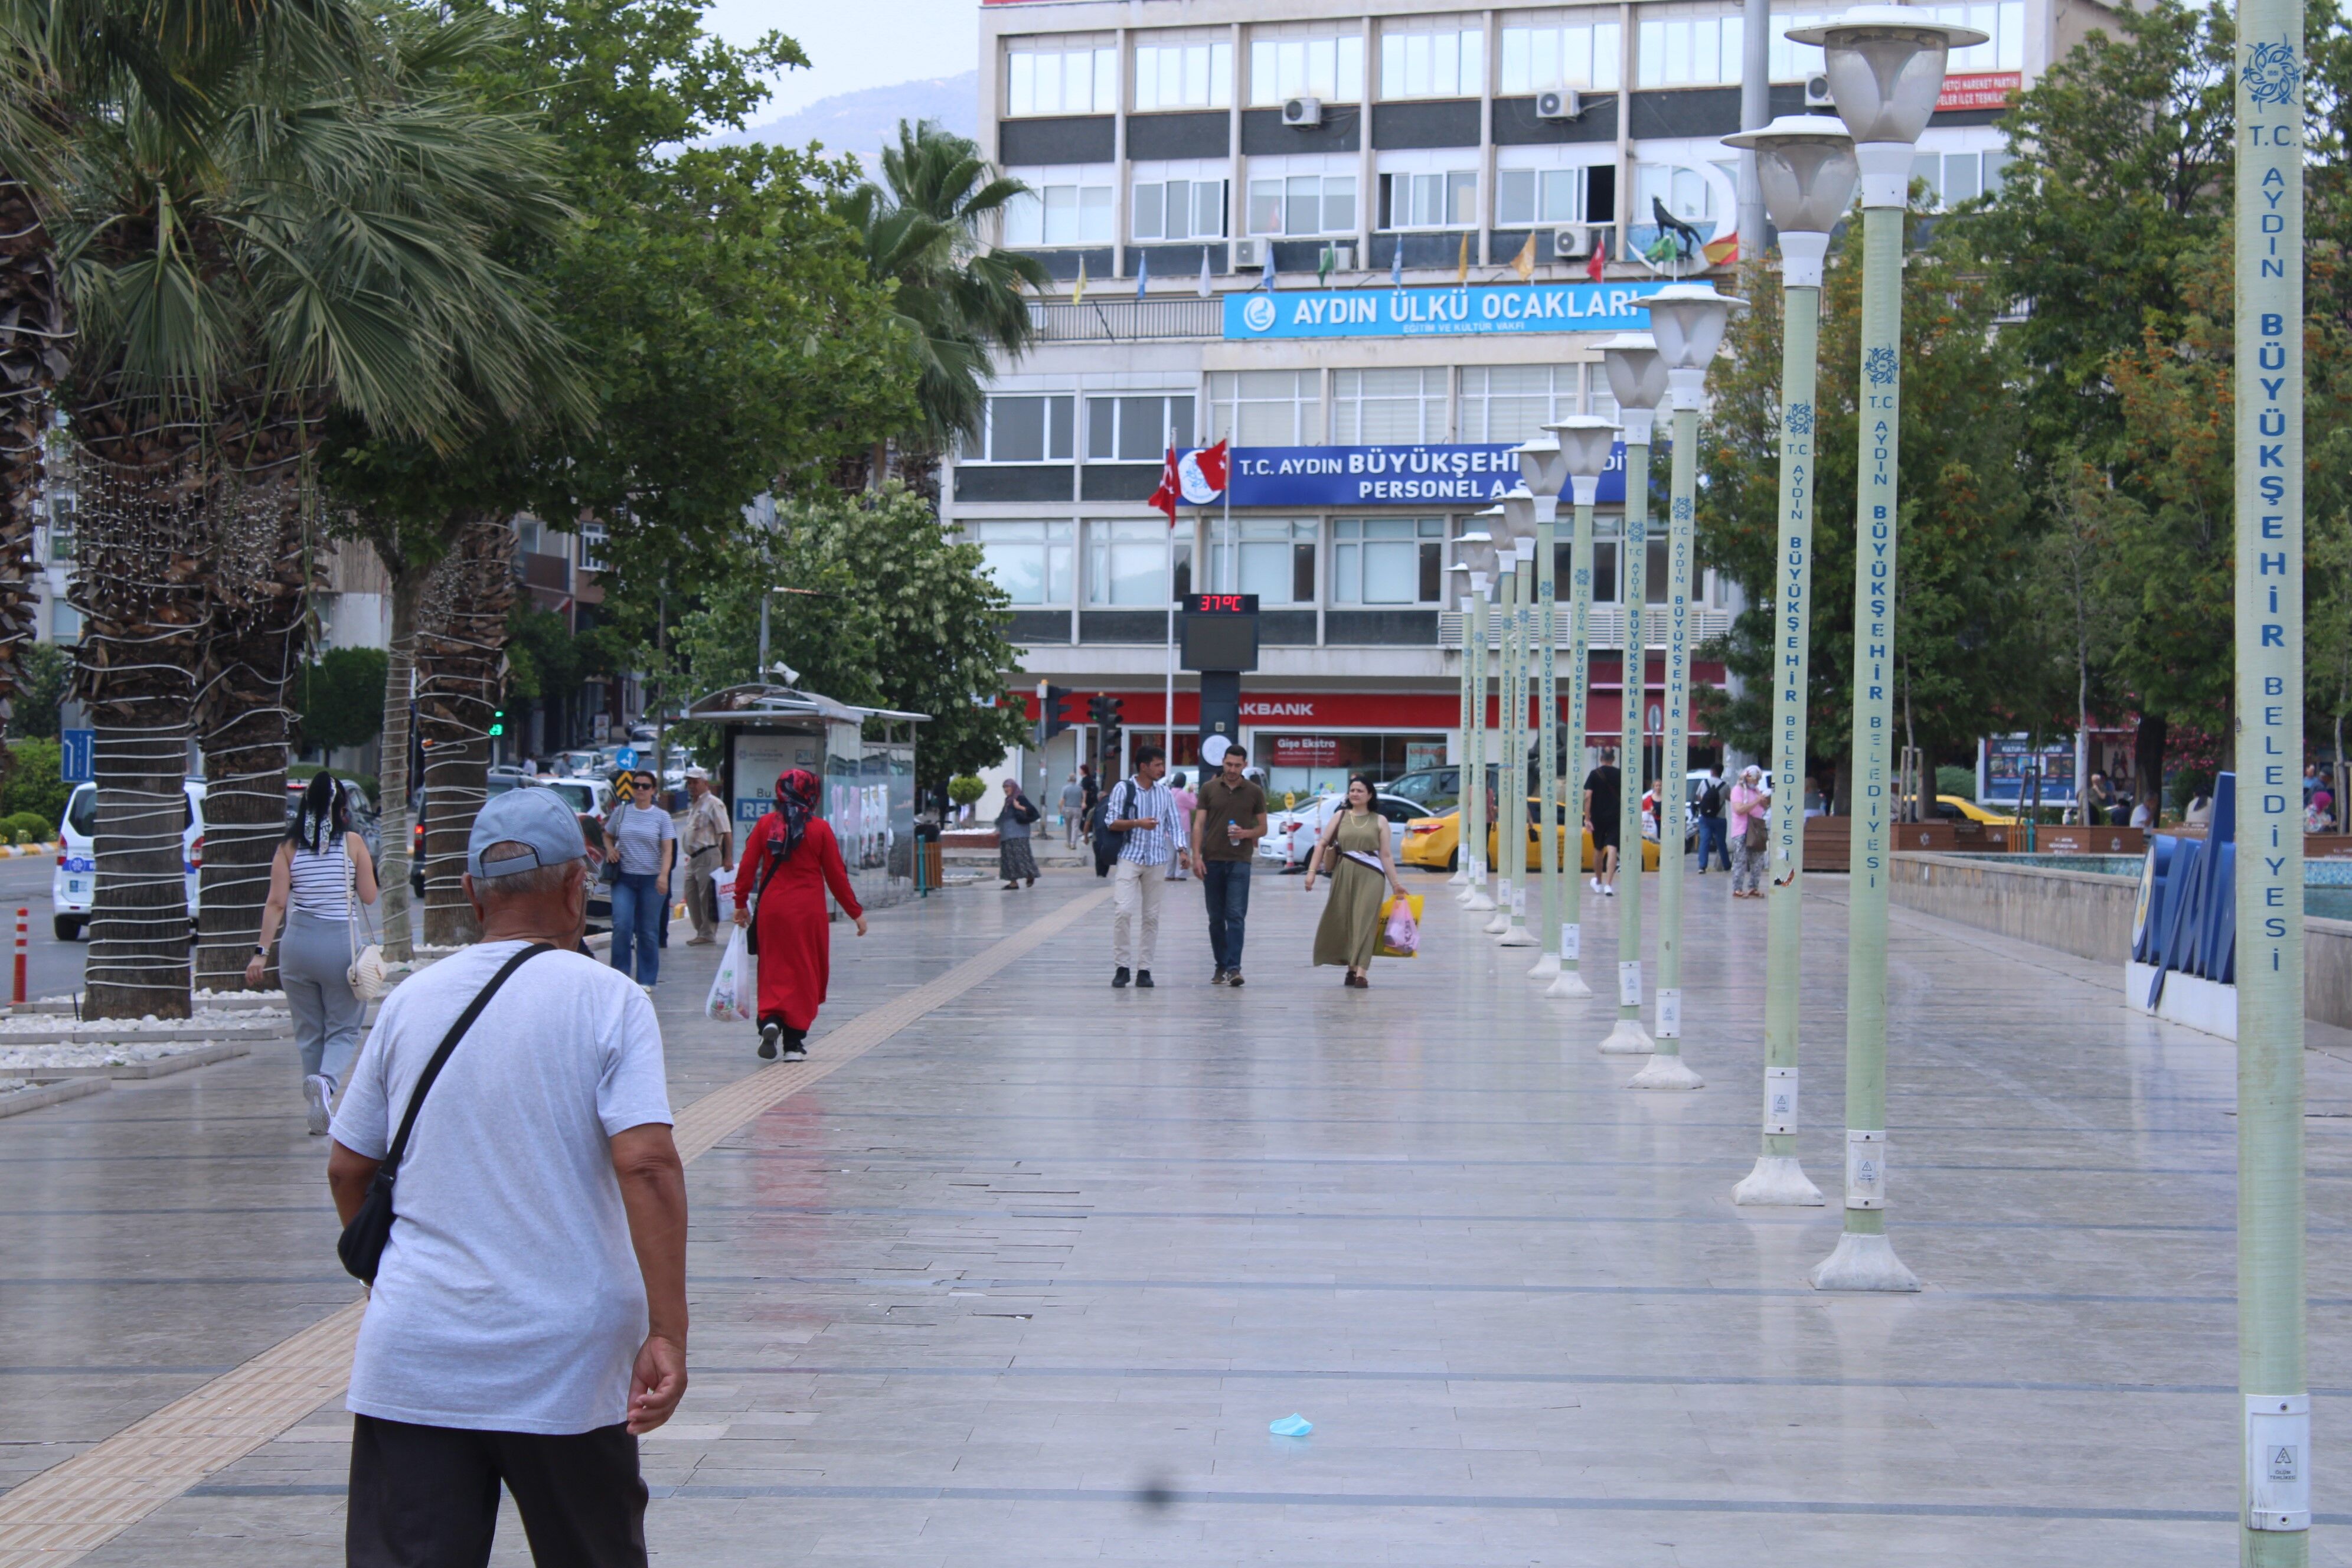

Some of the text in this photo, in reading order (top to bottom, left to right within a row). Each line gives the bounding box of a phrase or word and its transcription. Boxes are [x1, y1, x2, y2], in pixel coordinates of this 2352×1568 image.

[1293, 289, 1638, 325] AYDIN ÜLKÜ OCAKLARI
[1403, 321, 1525, 333] EĞİTİM VE KÜLTÜR VAKFI
[1239, 459, 1275, 476] T.C.
[1279, 458, 1343, 475] AYDIN
[1874, 420, 1888, 485] AYDIN
[1359, 479, 1484, 499] PERSONEL
[1791, 465, 1804, 520] AYDIN
[1675, 543, 1684, 583] AYDIN
[2248, 125, 2297, 971] T.C. AYDIN BÜYÜKŞEHİR BELEDİYESİ
[1631, 563, 1639, 599] AYDIN
[1870, 505, 1888, 700] BÜYÜKŞEHİR
[1785, 537, 1802, 703] BÜYÜKŞEHİR
[1574, 639, 1584, 729] BÜYÜKŞEHİR
[1629, 610, 1639, 719] BÜYÜKŞEHİR
[1671, 596, 1684, 718] BÜYÜKŞEHİR
[1302, 738, 1337, 749] Ekstra
[1782, 716, 1796, 862] BELEDİYESİ
[1867, 716, 1881, 888] BELEDİYESİ
